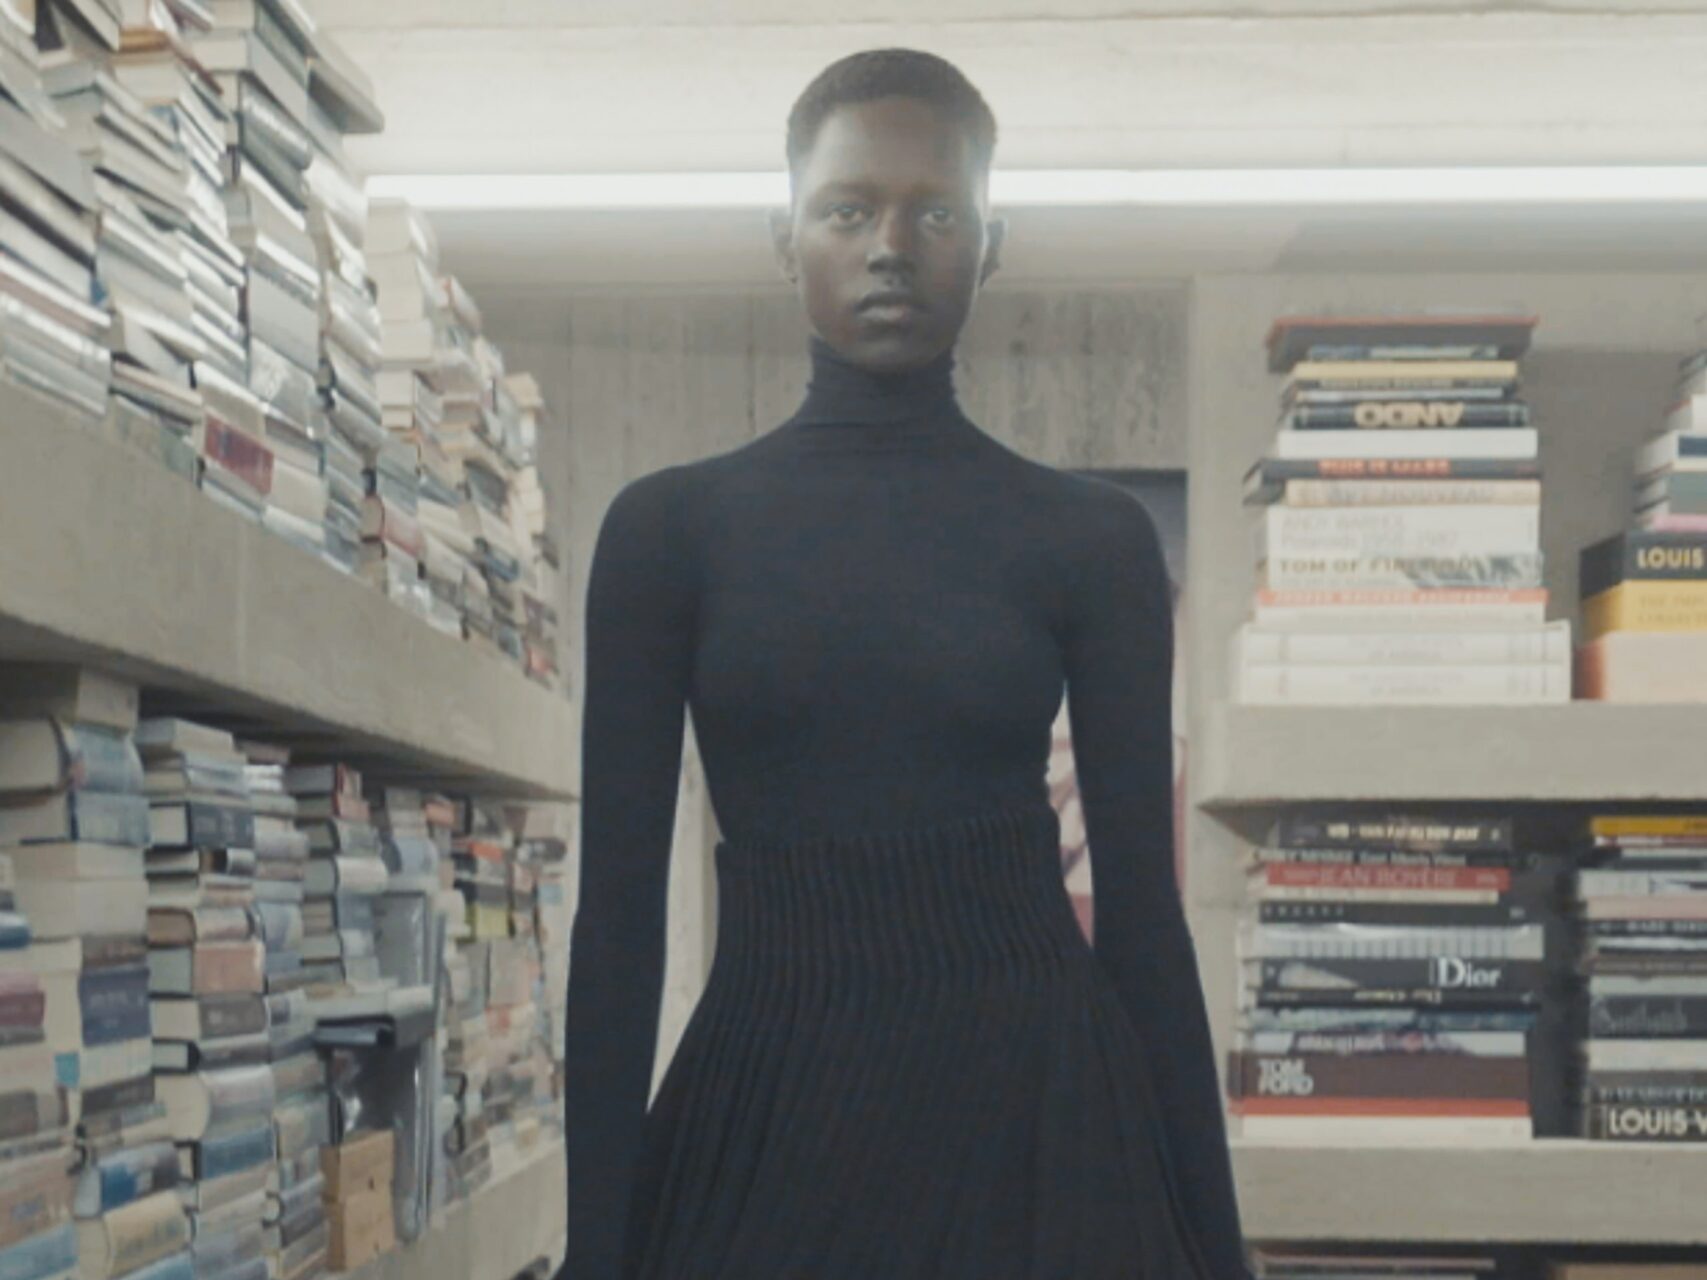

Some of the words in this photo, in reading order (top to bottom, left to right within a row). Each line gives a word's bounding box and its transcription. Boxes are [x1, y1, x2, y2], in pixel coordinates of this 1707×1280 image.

[1354, 402, 1464, 427] ANDO
[1280, 558, 1325, 573] TOM
[1333, 558, 1358, 573] OF
[1637, 547, 1703, 569] LOUIS
[1438, 957, 1502, 988] Dior
[1258, 1059, 1304, 1076] TOM
[1258, 1075, 1314, 1095] FORD
[1609, 1107, 1688, 1136] LOUIS
